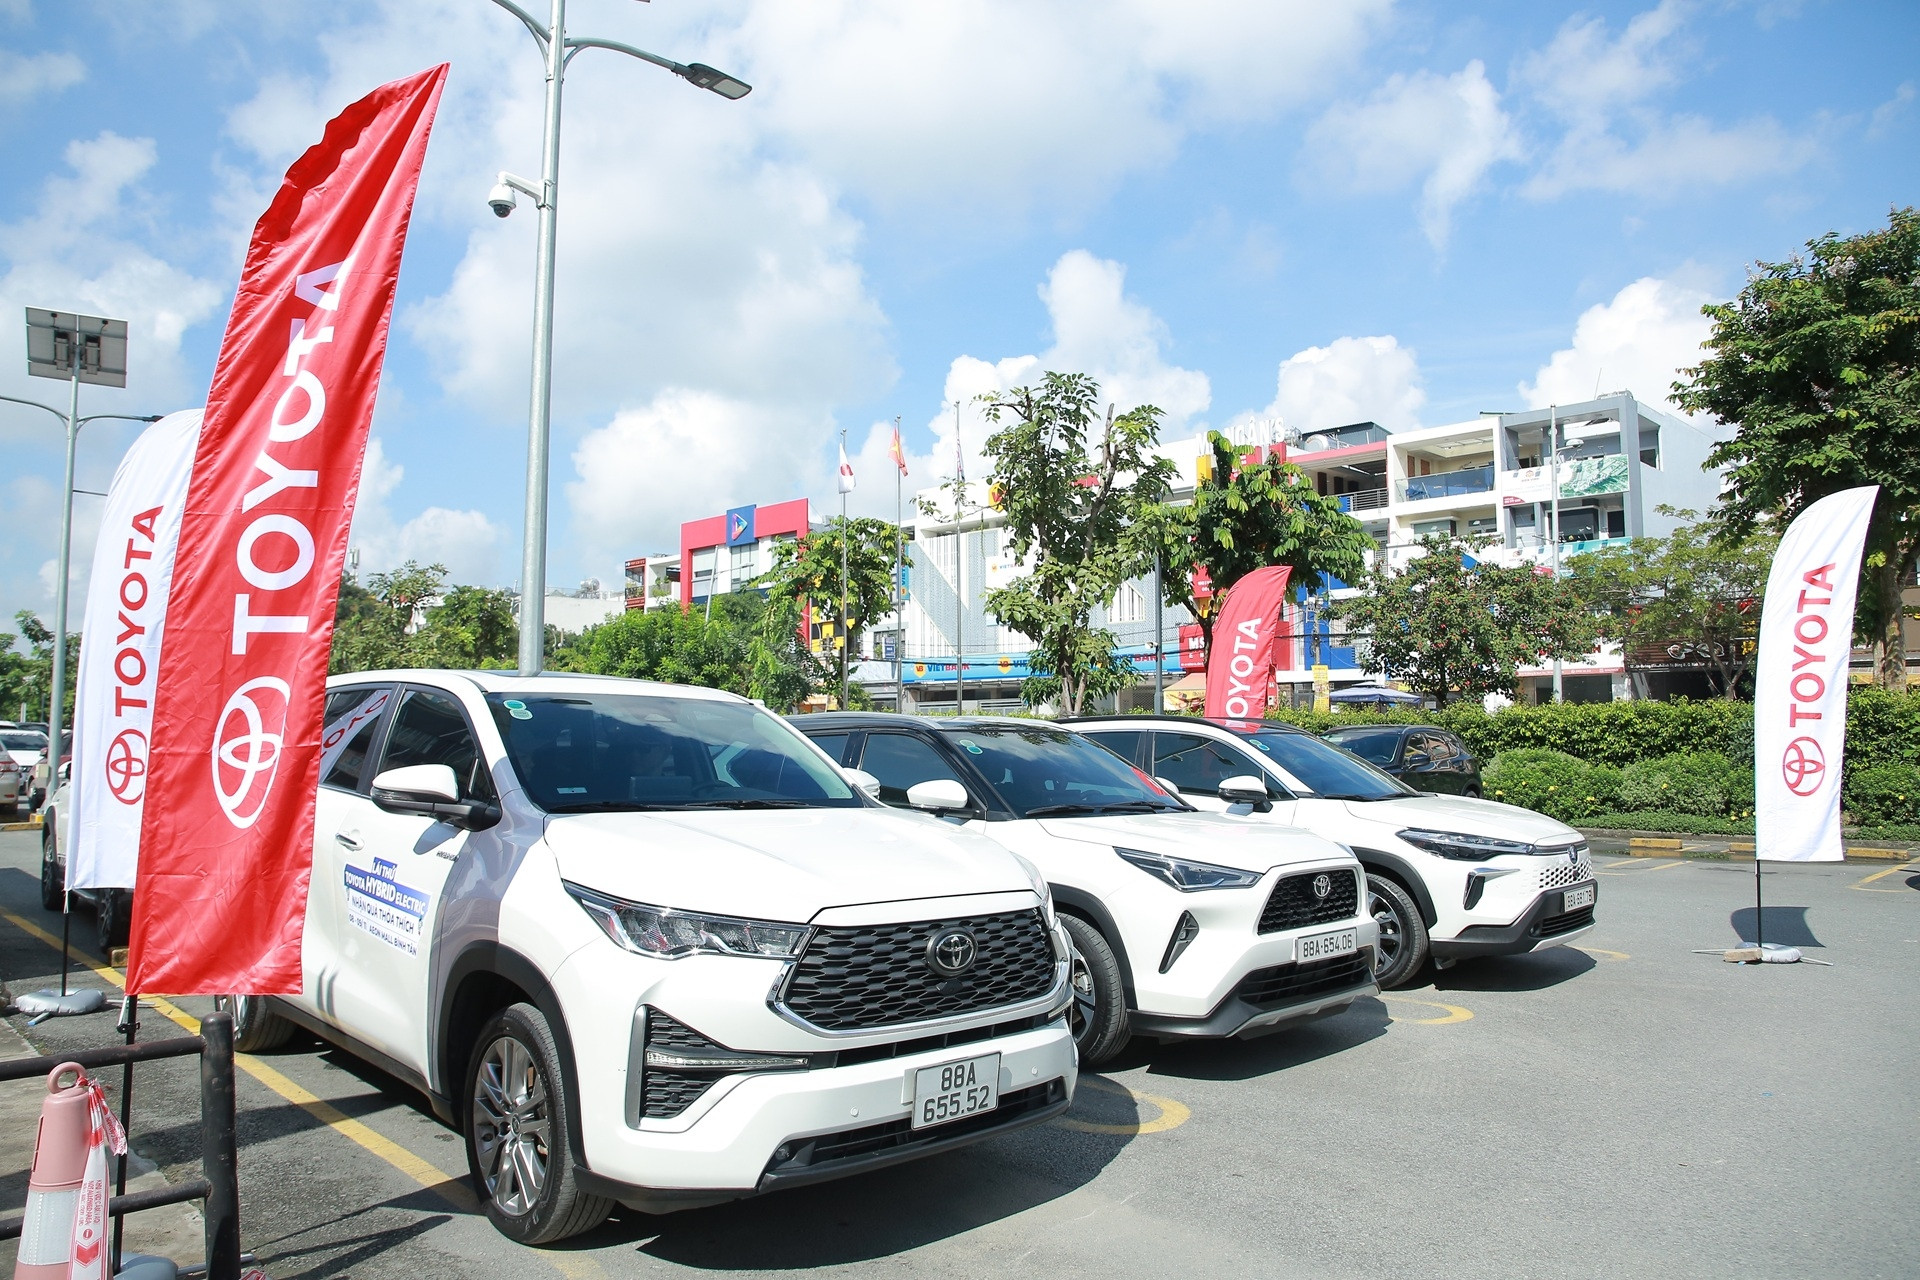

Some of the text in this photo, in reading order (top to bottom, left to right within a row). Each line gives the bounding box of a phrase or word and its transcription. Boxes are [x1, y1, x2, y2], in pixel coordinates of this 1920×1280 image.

[231, 252, 357, 655] TOYOTA
[114, 505, 164, 717] TOYOTA
[1789, 562, 1836, 728] TOYOTA
[928, 663, 970, 672] VIETBAK
[1225, 617, 1262, 718] OYOTA
[365, 876, 396, 902] HYBRID
[396, 894, 426, 915] ELECTRIC
[1303, 934, 1353, 957] 88A-654.06
[941, 1062, 976, 1092] 88A
[923, 1085, 990, 1122] 655.52
